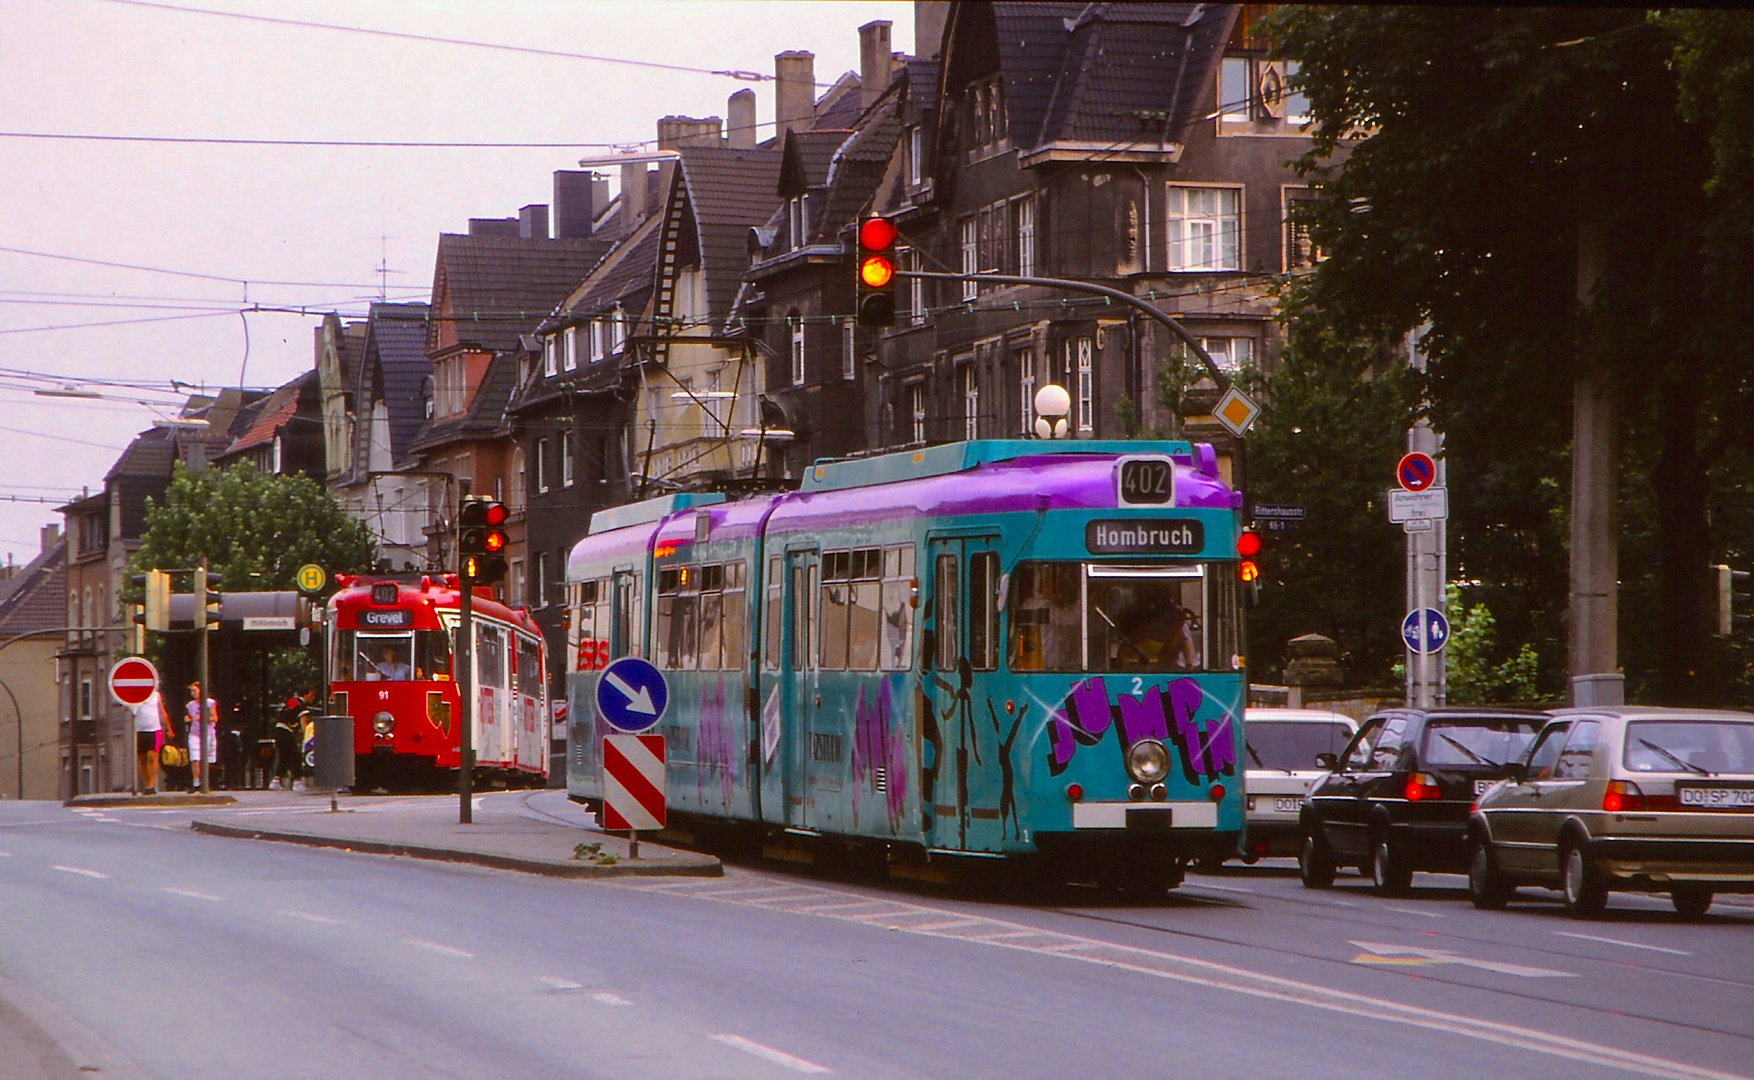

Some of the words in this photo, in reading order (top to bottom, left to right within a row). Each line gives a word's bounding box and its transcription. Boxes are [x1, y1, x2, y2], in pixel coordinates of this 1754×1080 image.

[1125, 465, 1167, 494] 402
[1395, 493, 1434, 502] Anwohner
[1411, 508, 1427, 518] frei
[1096, 525, 1193, 546] Hombruch
[305, 571, 318, 586] H
[374, 587, 396, 602] 402
[366, 611, 404, 624] Grevel
[1131, 676, 1143, 695] 2
[378, 690, 389, 700] 91
[1683, 789, 1703, 804] DO
[1711, 790, 1730, 804] SP
